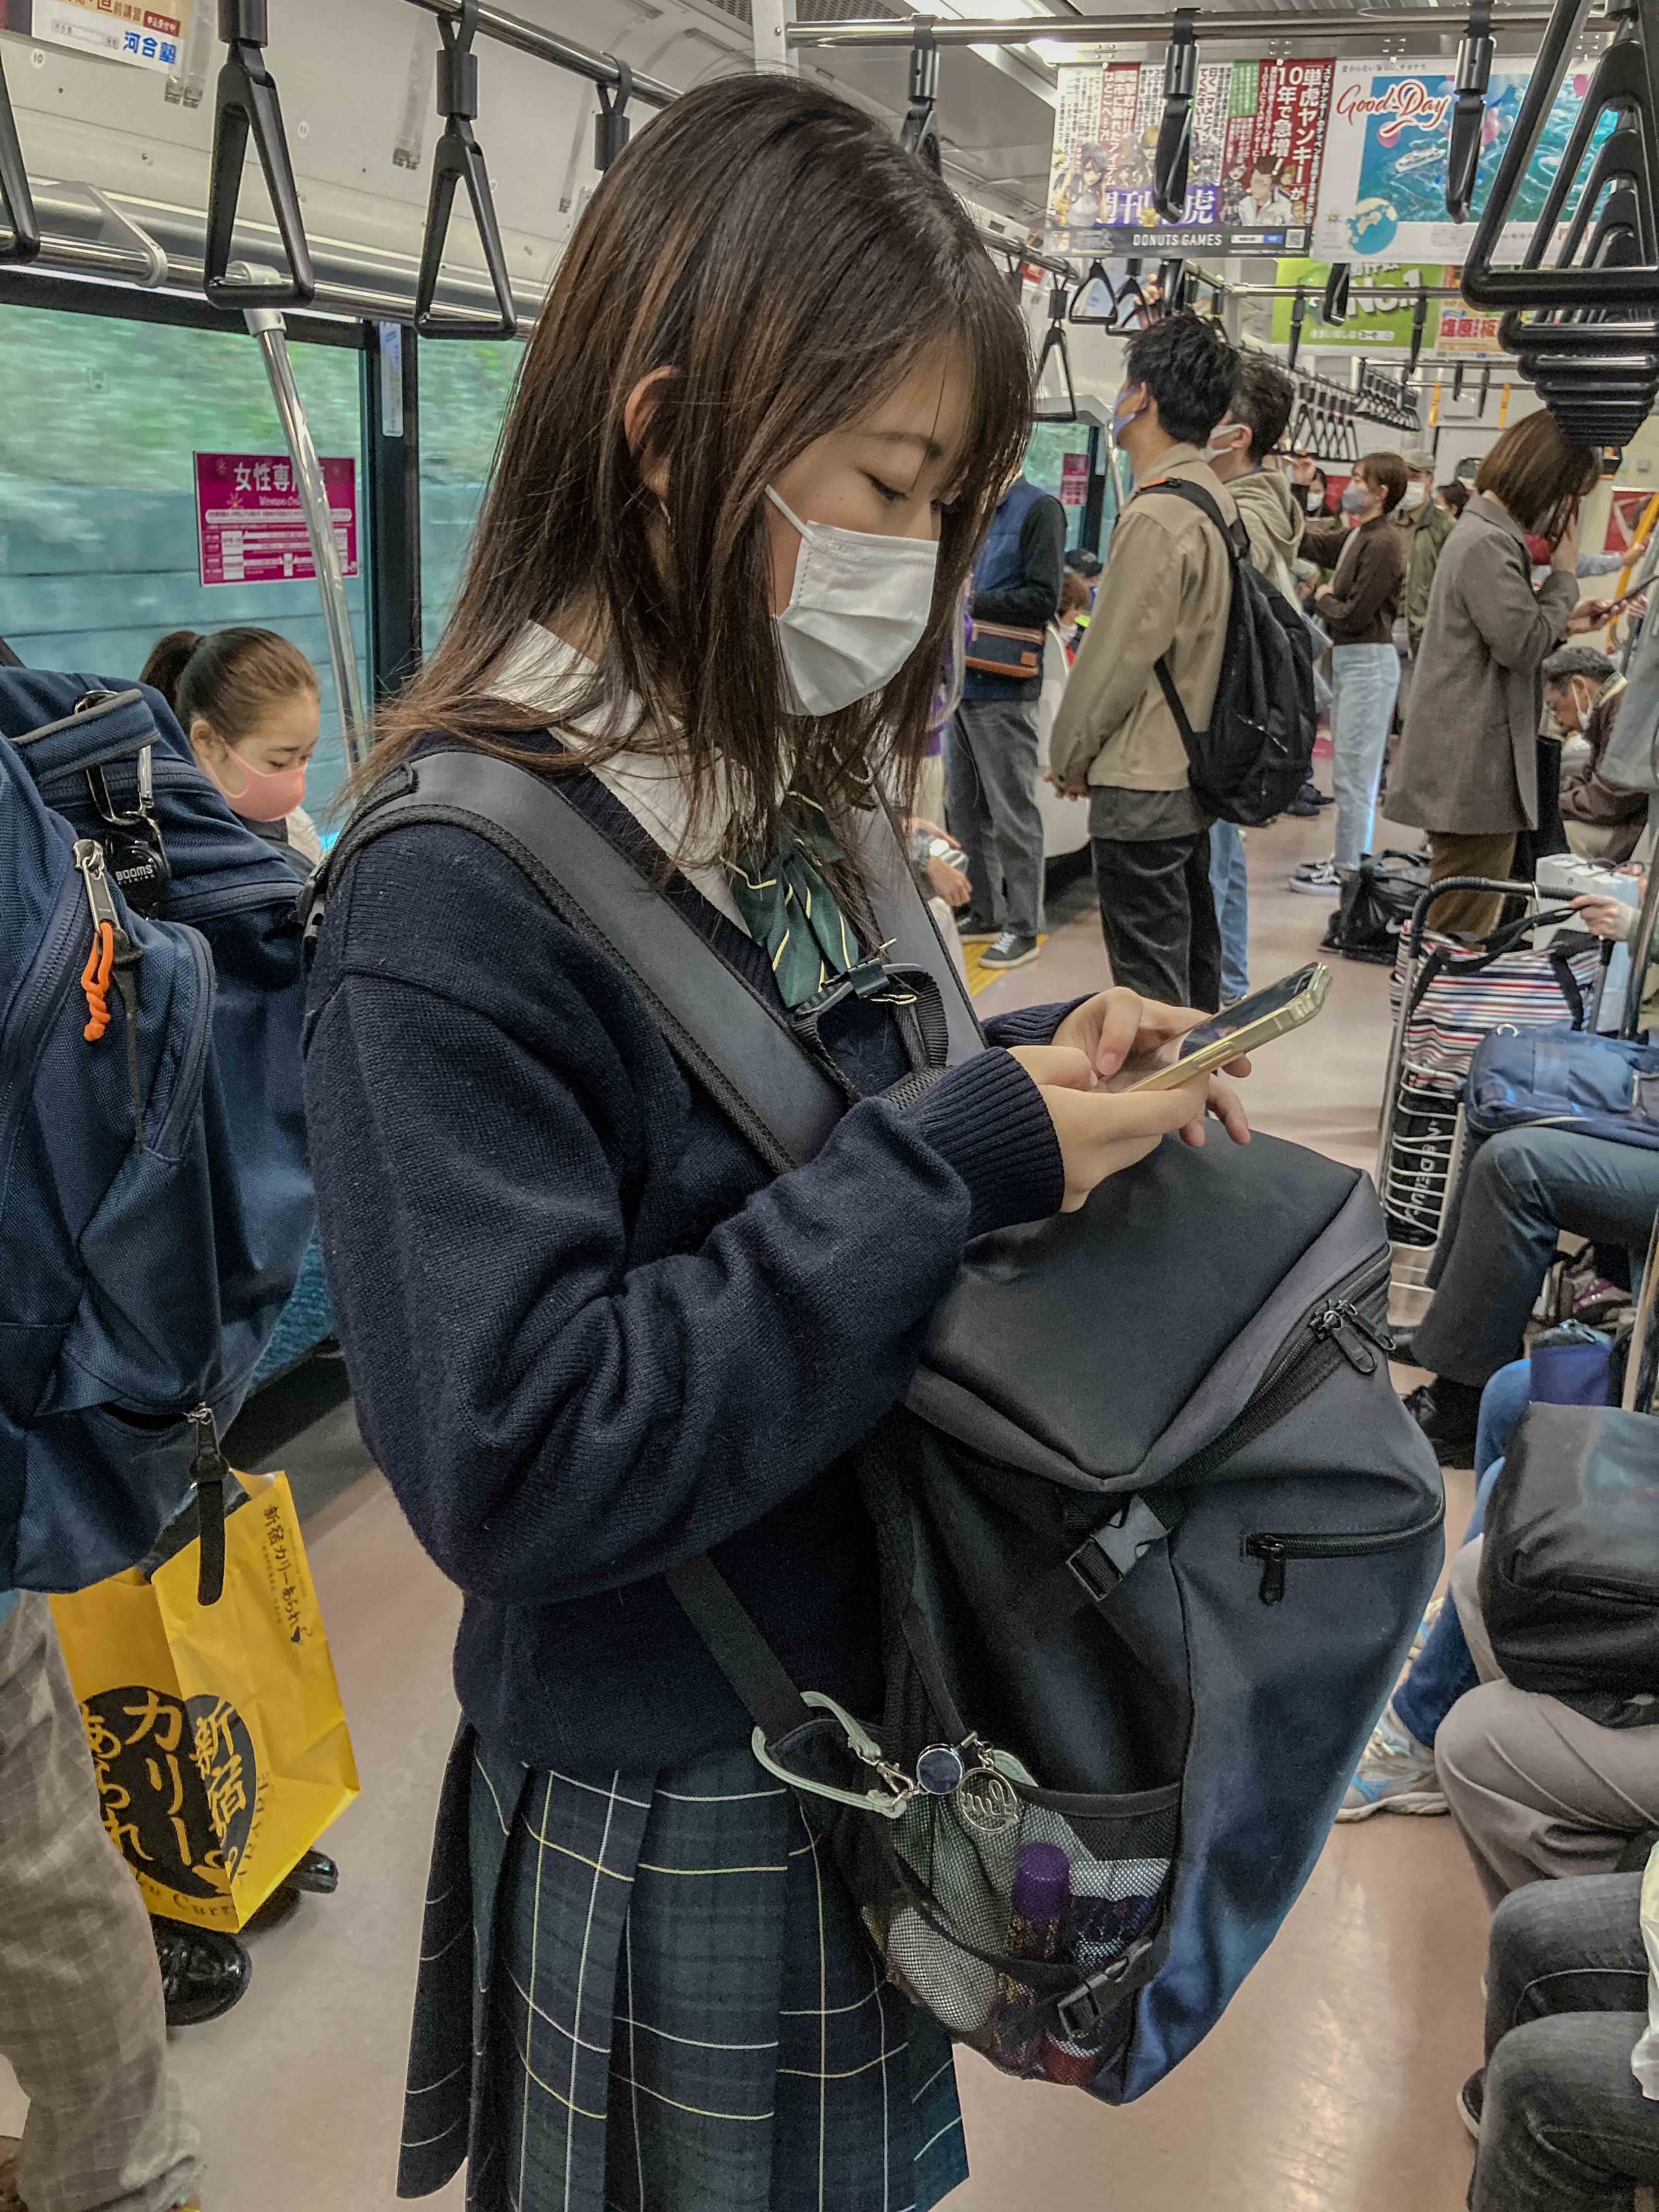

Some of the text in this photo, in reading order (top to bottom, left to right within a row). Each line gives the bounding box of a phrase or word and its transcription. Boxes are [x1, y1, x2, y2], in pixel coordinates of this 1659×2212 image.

[122, 31, 176, 64] 河合塾
[1133, 234, 1179, 246] DONUTS
[1182, 234, 1222, 246] GAMES
[234, 462, 325, 492] 女性専
[115, 864, 153, 881] BOOMS
[123, 1690, 191, 1866] カリー
[173, 1893, 236, 1916] Curr
